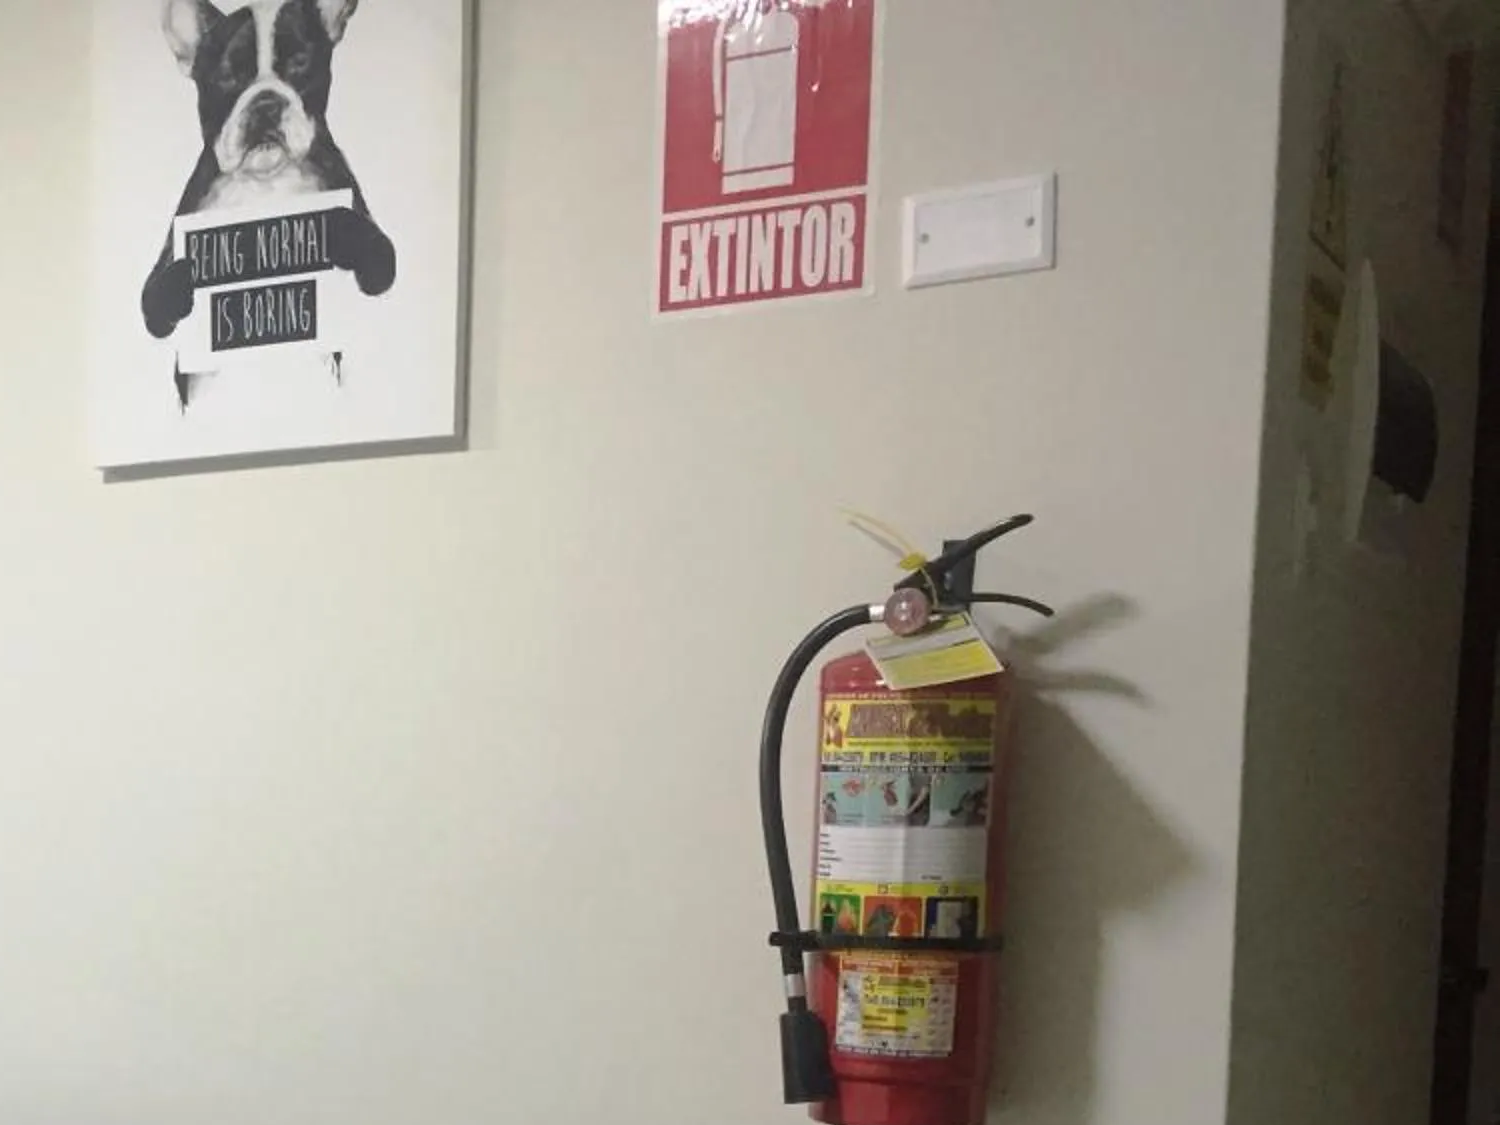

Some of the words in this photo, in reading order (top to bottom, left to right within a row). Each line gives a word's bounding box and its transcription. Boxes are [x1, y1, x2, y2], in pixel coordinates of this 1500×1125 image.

[189, 231, 244, 282] BEING
[256, 214, 332, 272] NORMAL
[667, 200, 857, 304] EXTINTOR
[216, 296, 235, 342] IS
[243, 288, 310, 340] BORING
